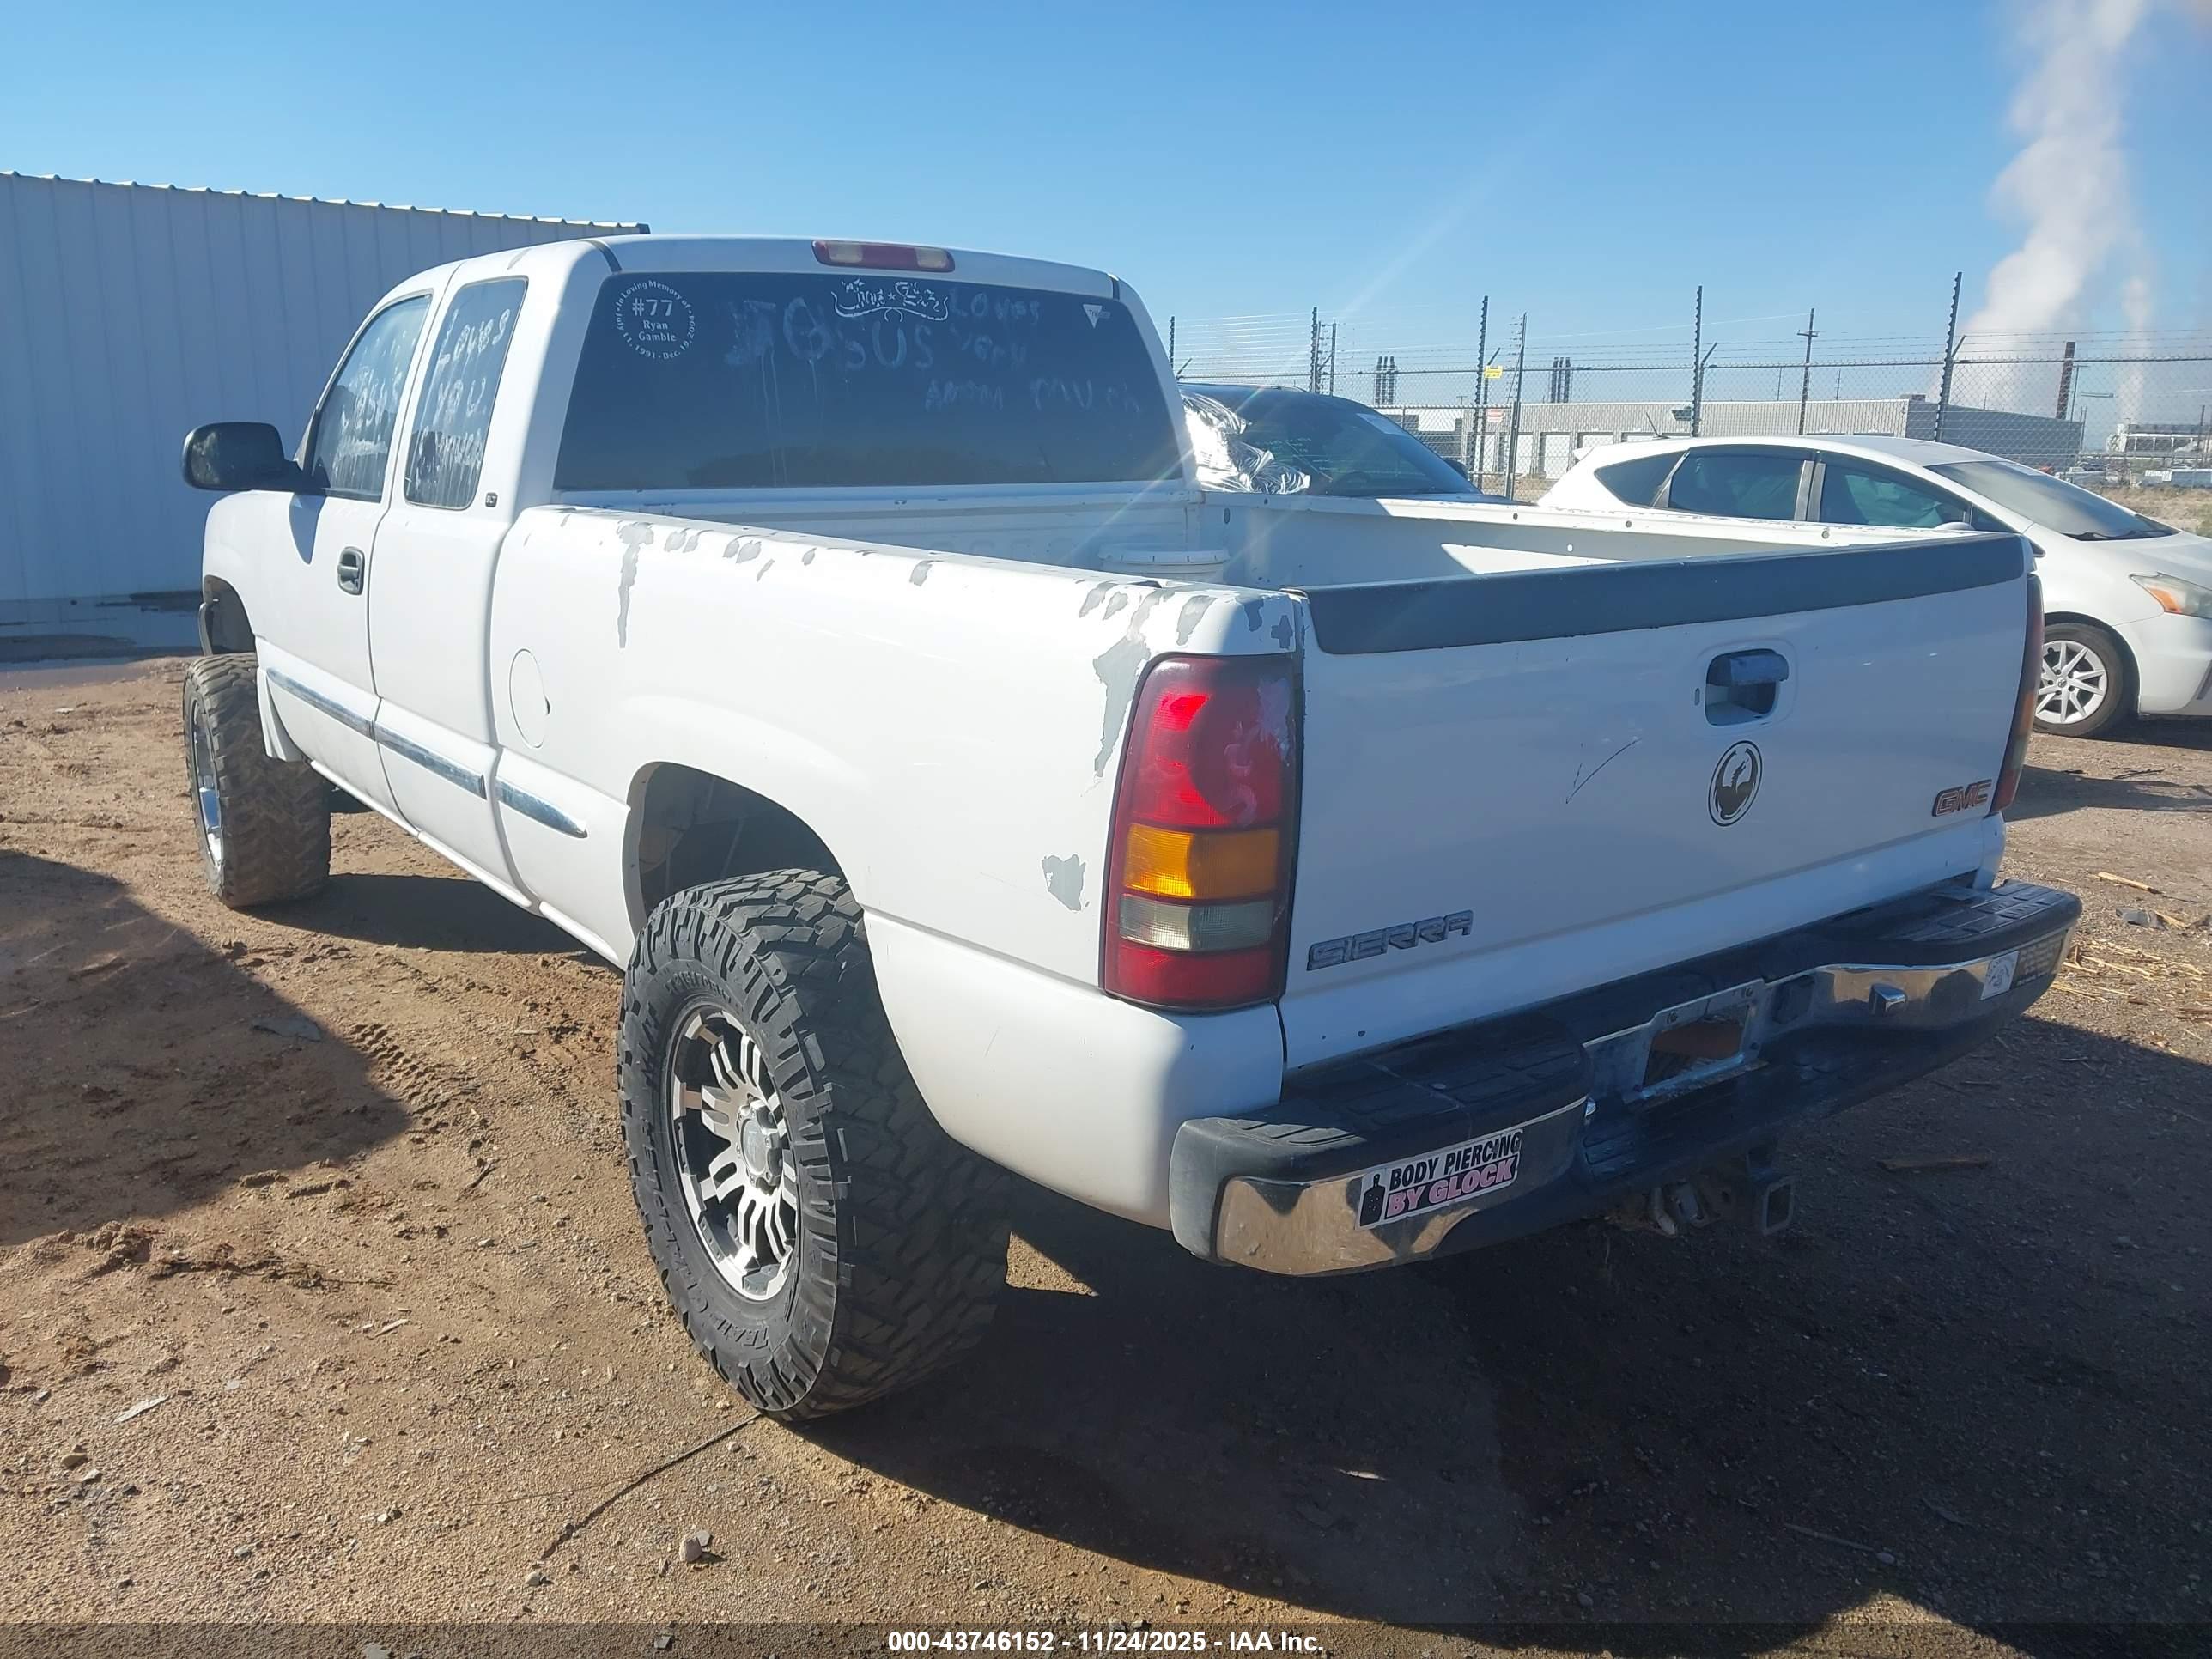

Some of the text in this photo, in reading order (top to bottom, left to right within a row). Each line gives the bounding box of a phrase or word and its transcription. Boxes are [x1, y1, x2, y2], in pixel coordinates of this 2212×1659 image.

[621, 282, 648, 298] Loving
[647, 280, 683, 300] Memory
[681, 298, 692, 308] of
[632, 298, 673, 317] #77
[615, 313, 625, 331] July
[635, 344, 656, 359] 1991
[638, 331, 678, 343] Gamble
[642, 319, 669, 331] Ryan
[1932, 778, 1992, 817] GMC
[1306, 909, 1474, 971] SIERRA
[1389, 1131, 1522, 1192] BODY PIERCING
[1386, 1156, 1516, 1218] BY GLOCK
